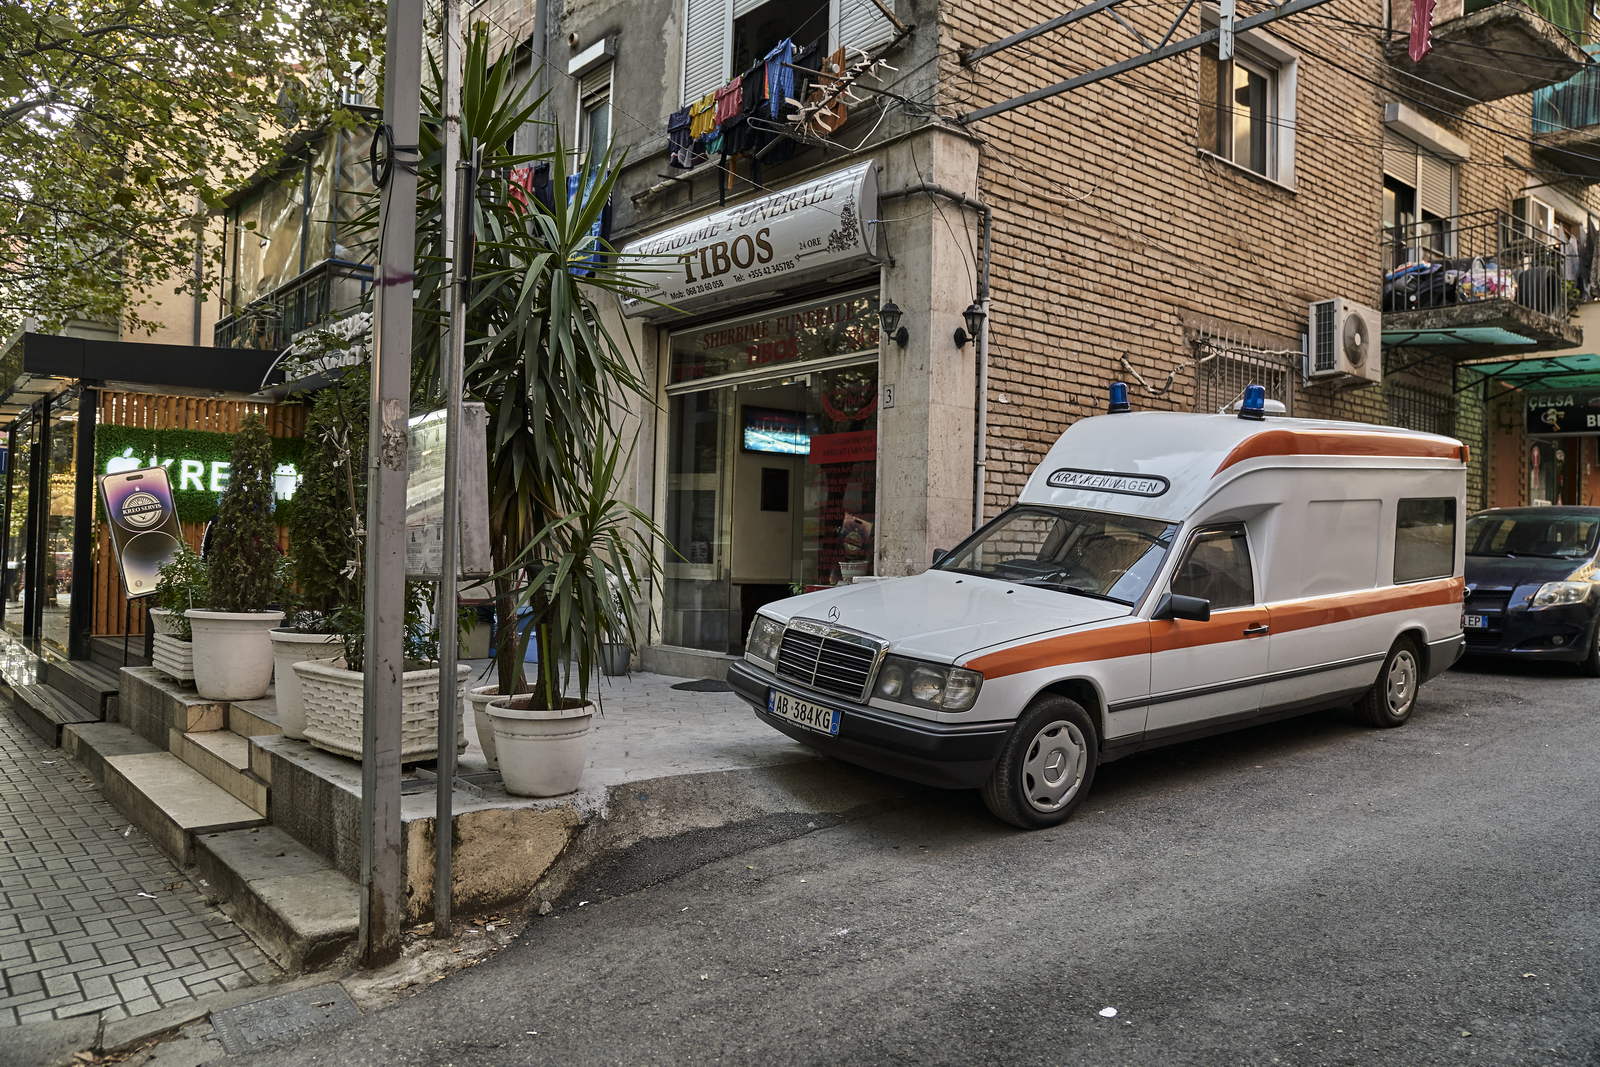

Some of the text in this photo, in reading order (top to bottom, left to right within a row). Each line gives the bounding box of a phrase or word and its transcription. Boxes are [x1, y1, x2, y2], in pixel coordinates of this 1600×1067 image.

[807, 237, 822, 247] ORE
[678, 228, 774, 284] TIBOS
[670, 290, 686, 300] Mob:
[686, 287, 697, 296] 068
[697, 285, 705, 293] 20
[713, 279, 725, 289] 058
[733, 273, 745, 283] Tel:
[747, 269, 763, 279] +355
[763, 266, 771, 275] 42
[772, 260, 795, 273] 345785
[703, 320, 769, 350] SHERBIME
[885, 388, 892, 404] 3
[123, 506, 141, 515] KREO
[776, 695, 788, 714] AB
